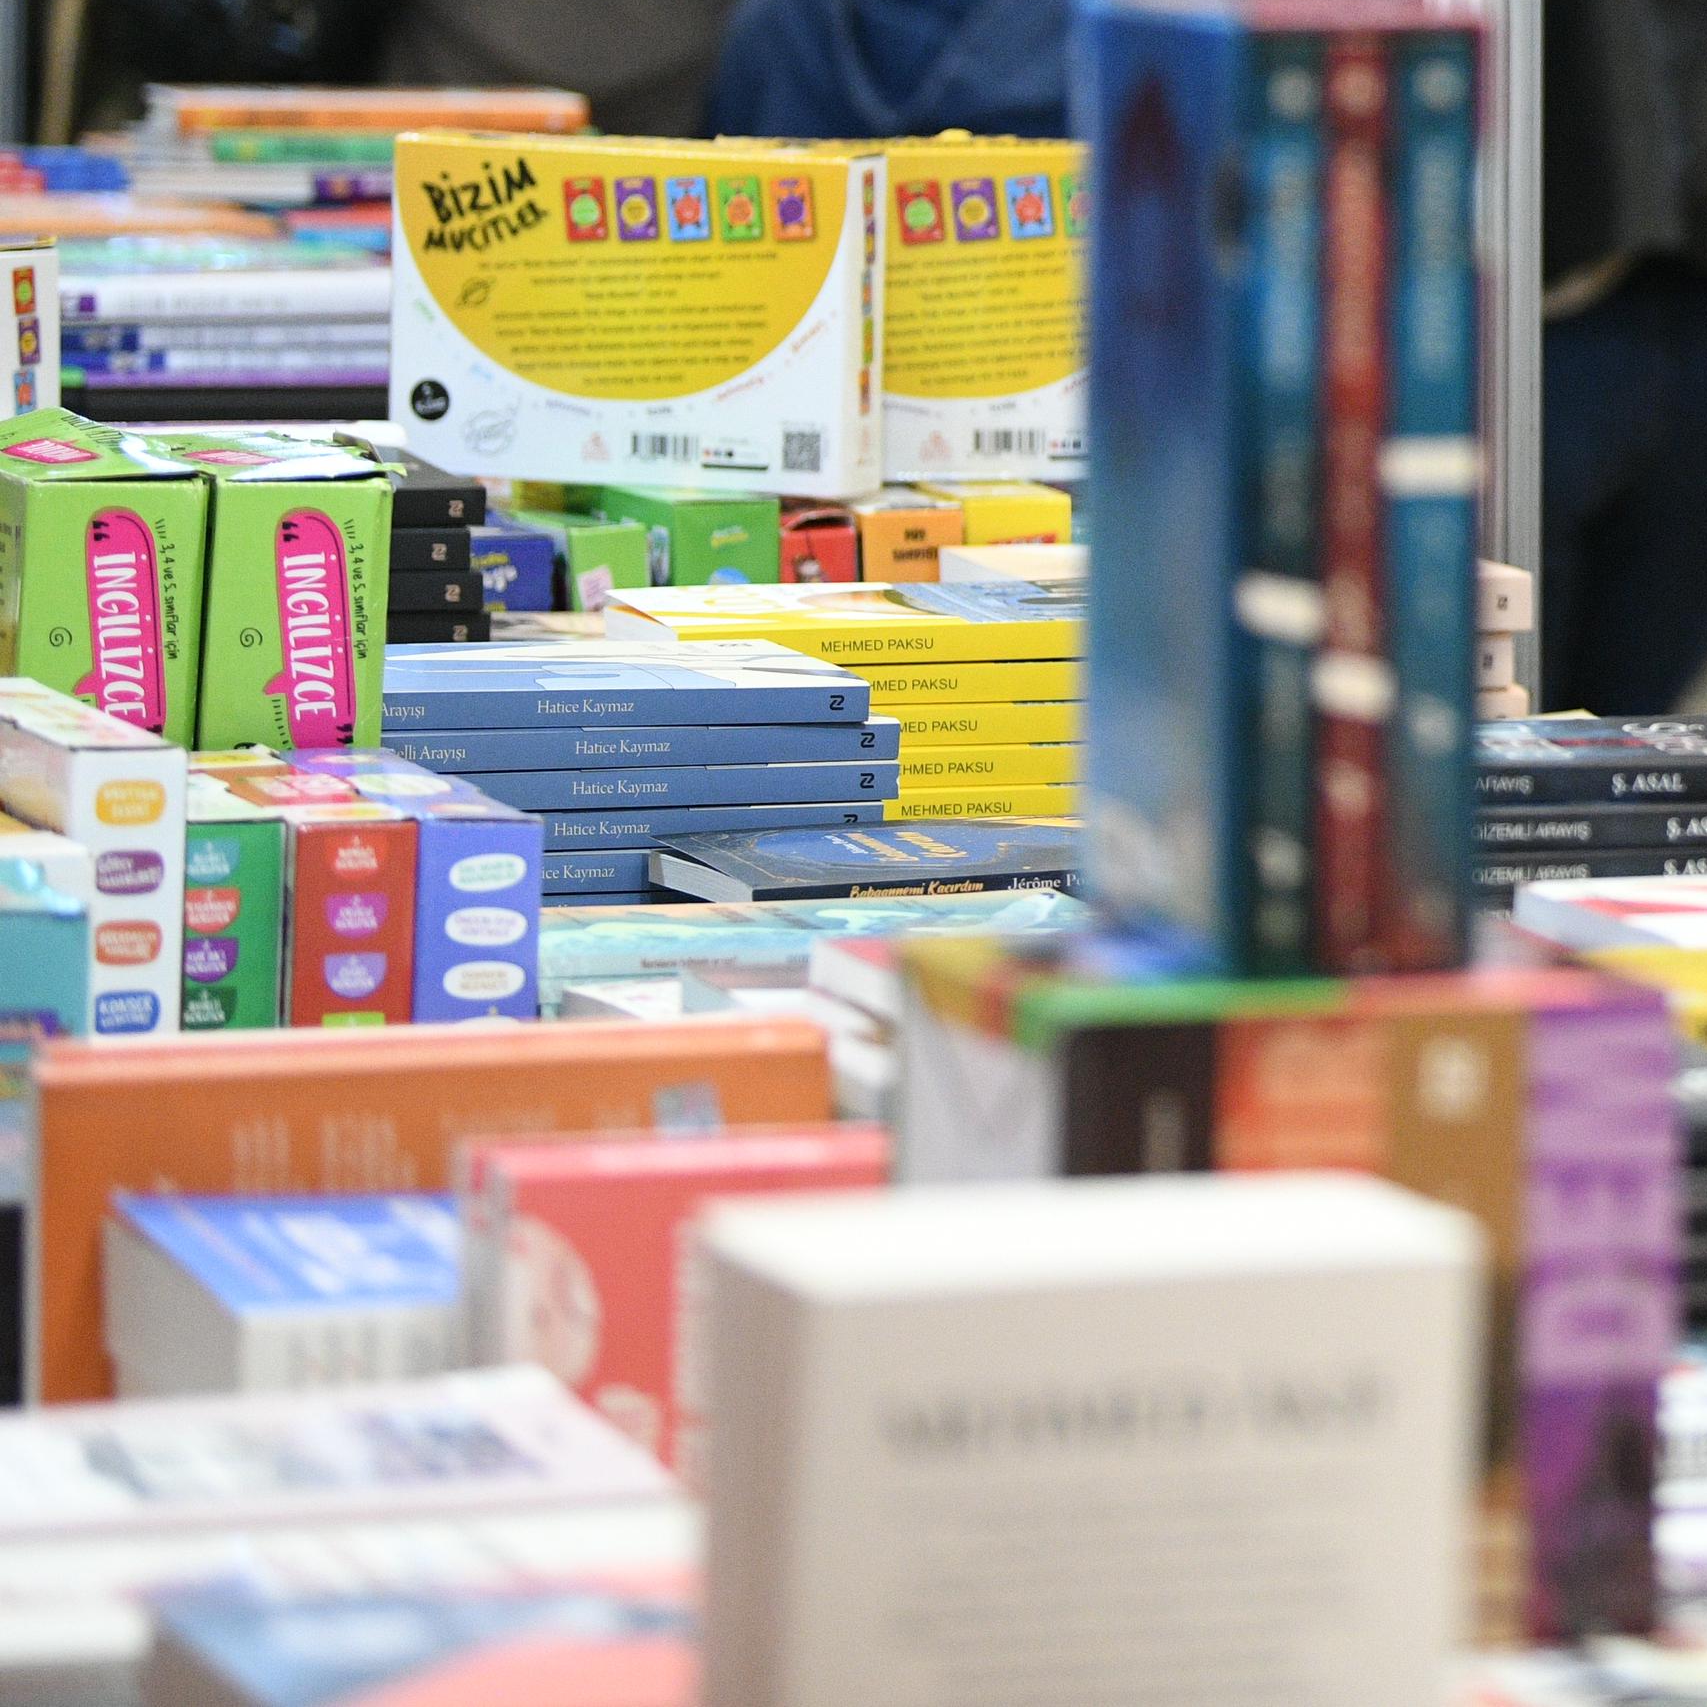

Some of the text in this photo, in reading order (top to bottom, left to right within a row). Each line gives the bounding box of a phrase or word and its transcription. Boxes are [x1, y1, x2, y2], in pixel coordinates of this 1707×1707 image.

[422, 157, 537, 224] BİZİM
[93, 551, 154, 719] İNGİLİZCE
[283, 551, 345, 721] İNGİLİZCE
[821, 638, 934, 653] MEHMED PAKSU
[870, 678, 958, 692] HMED PAKSU
[537, 699, 579, 714] Hatice
[582, 698, 635, 718] Kaymaz
[931, 719, 978, 733] PAKSU
[418, 746, 467, 763] Arayışı
[575, 741, 617, 755] Hatice
[619, 739, 671, 759] Kaymaz
[948, 761, 994, 774] PAKSU
[572, 779, 669, 799] Hatice Kaymaz
[1632, 772, 1687, 792] ASAL
[901, 802, 1013, 817] MEHMED PAKSU
[554, 820, 650, 840] Hatice Kaymaz
[563, 863, 616, 883] Kaymaz
[1007, 877, 1060, 891] Jérôme
